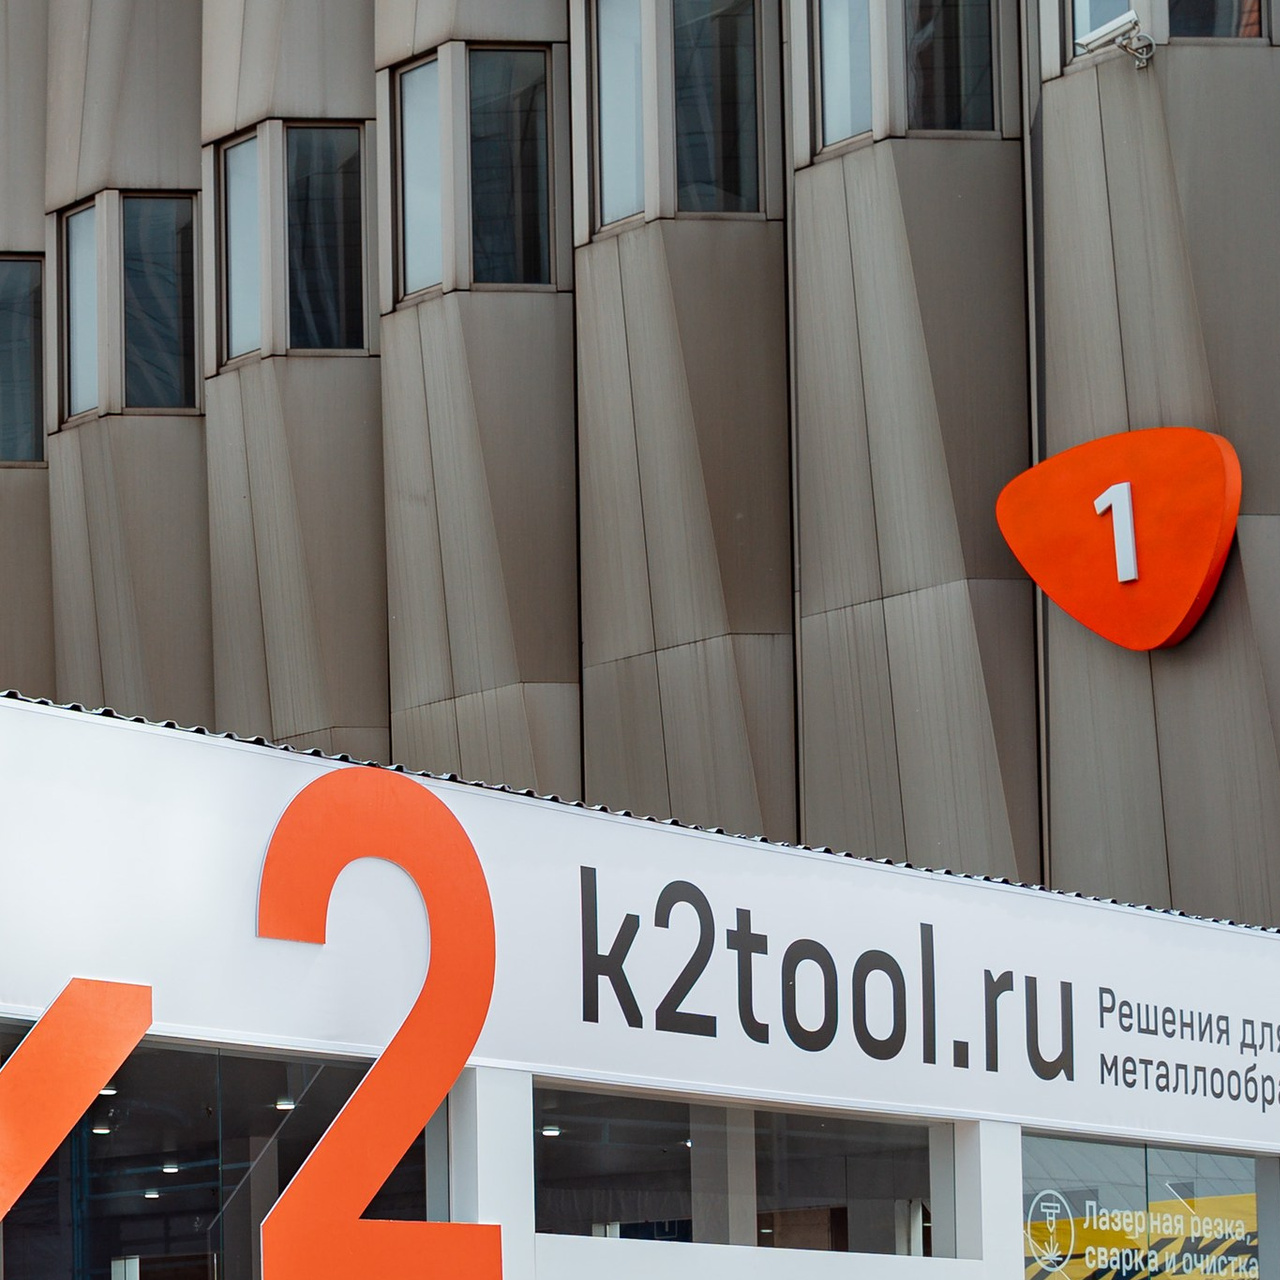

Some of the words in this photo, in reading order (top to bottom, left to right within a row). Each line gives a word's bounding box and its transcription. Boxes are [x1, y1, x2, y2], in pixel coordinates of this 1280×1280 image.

[1093, 481, 1138, 583] 1
[580, 865, 1075, 1082] k2tool.ru
[1098, 986, 1230, 1046] Решения
[1099, 1053, 1280, 1113] металлообр
[1083, 1200, 1184, 1238] Лазерная
[1190, 1215, 1251, 1246] резка,
[1085, 1245, 1159, 1276] сварка
[1164, 1251, 1176, 1273] и
[1182, 1252, 1259, 1279] очистка
